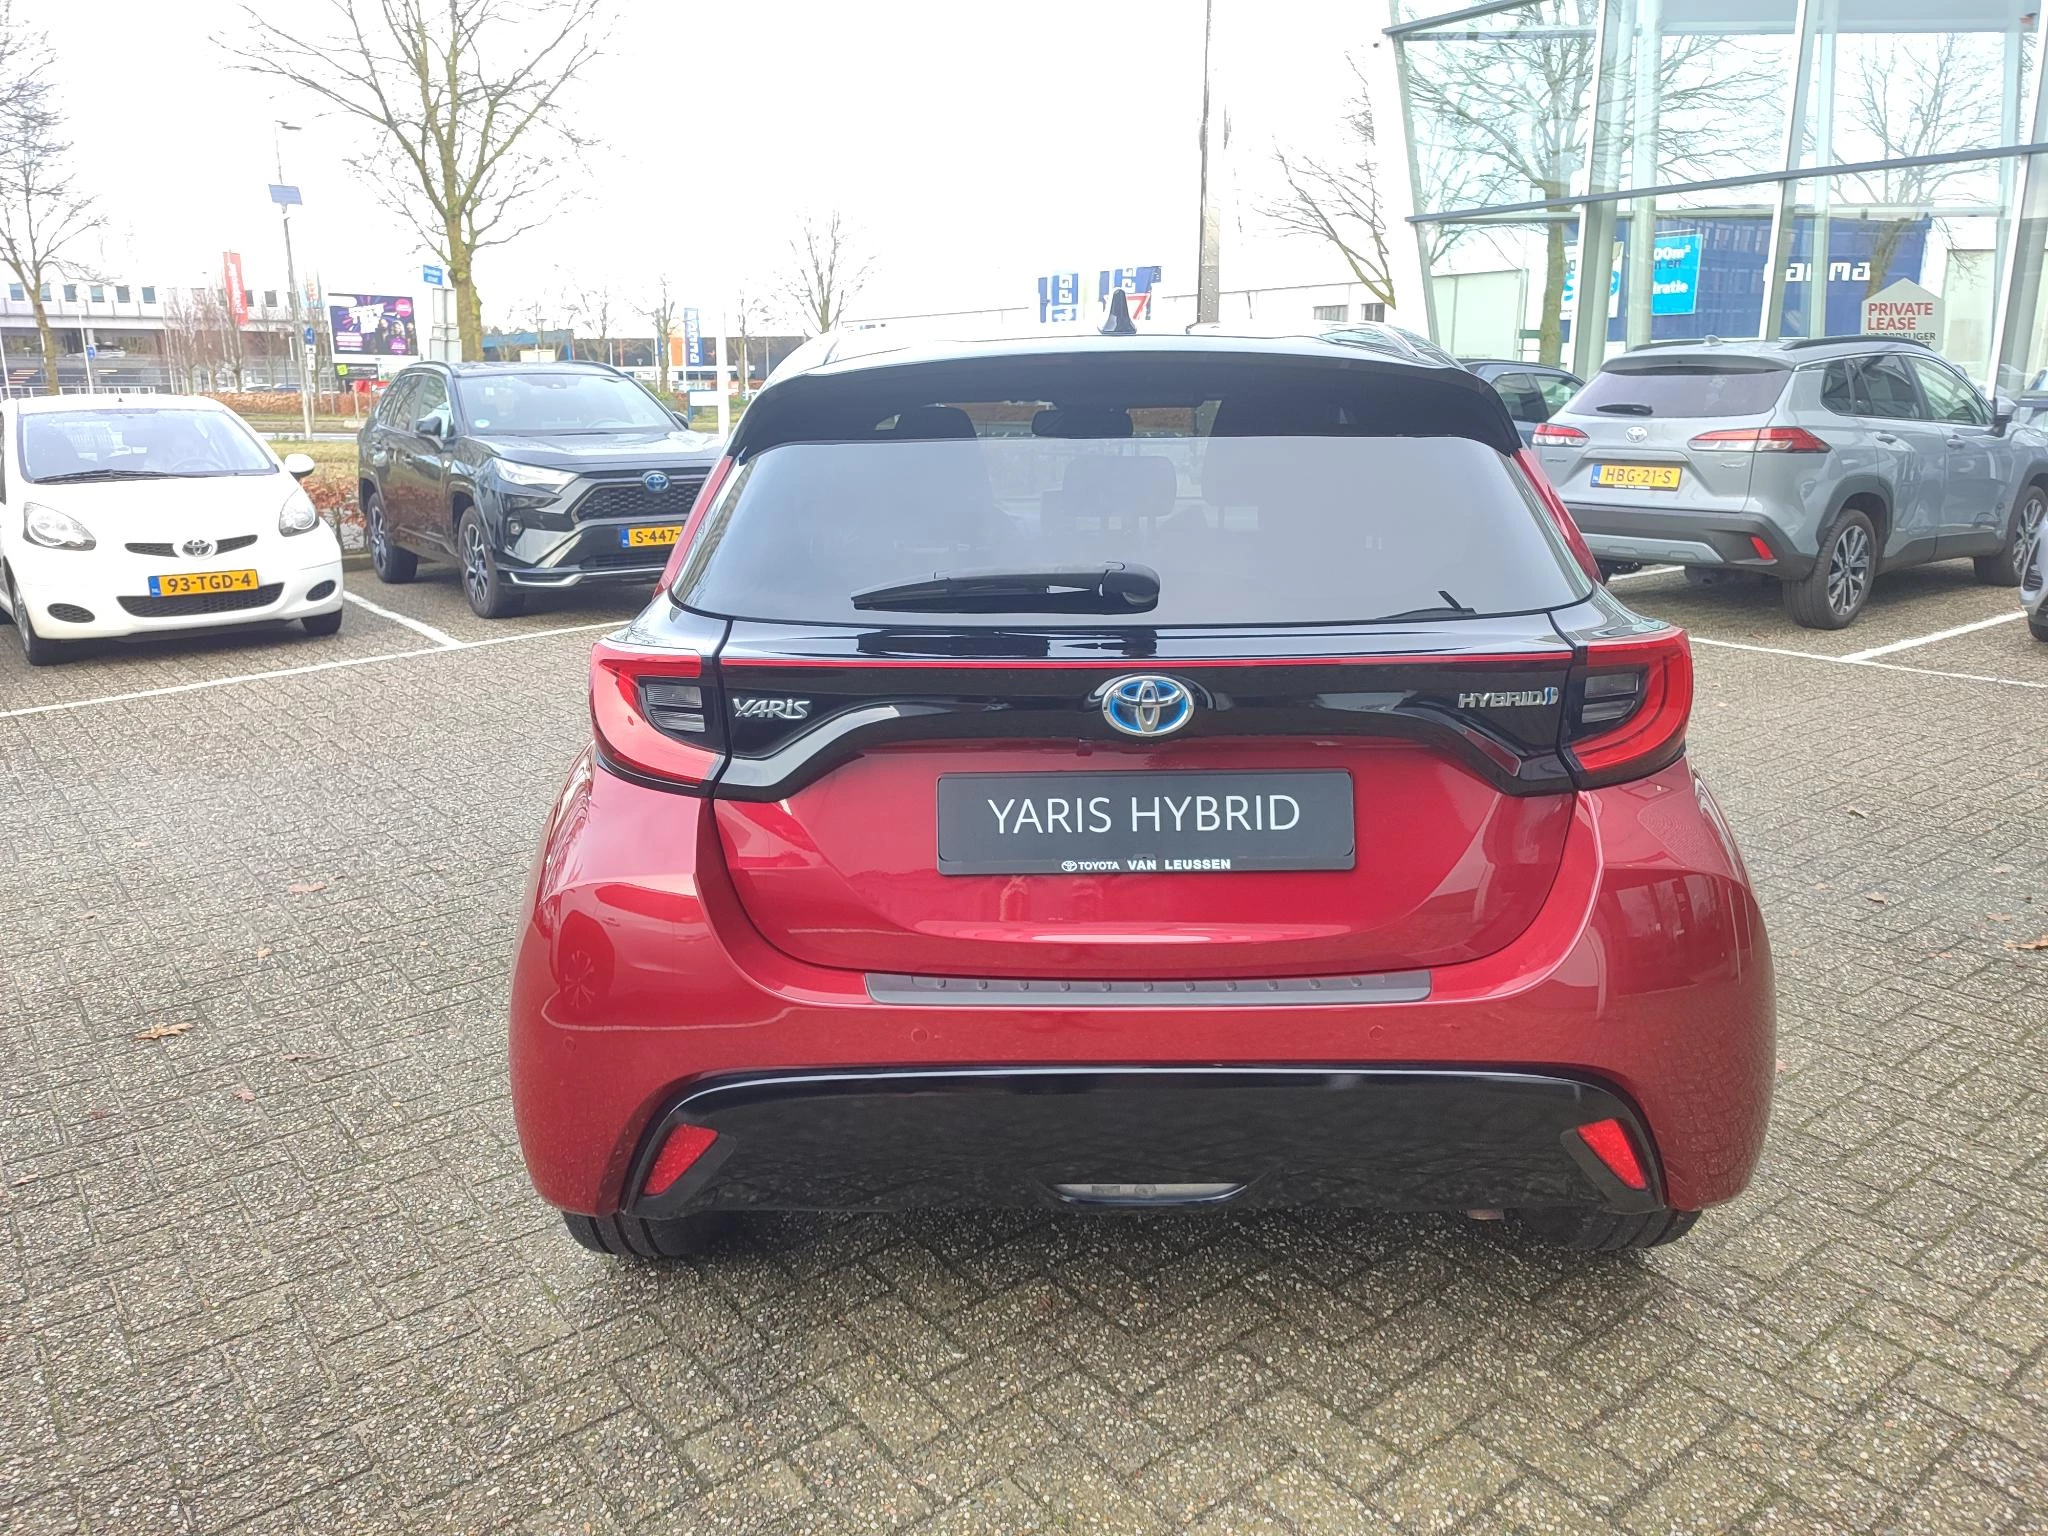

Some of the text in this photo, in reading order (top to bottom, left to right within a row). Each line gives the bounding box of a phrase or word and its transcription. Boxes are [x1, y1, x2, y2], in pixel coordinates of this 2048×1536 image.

[1868, 302, 1934, 316] PRIVATE
[1867, 316, 1917, 331] LEASE
[1605, 467, 1672, 484] HBG-21-S
[167, 573, 252, 593] 93-TGD-4
[1458, 690, 1545, 709] HYBRID
[987, 794, 1300, 835] YARIS HYBRID
[1077, 858, 1231, 871] TOYOTA VAN LEUSSEN
